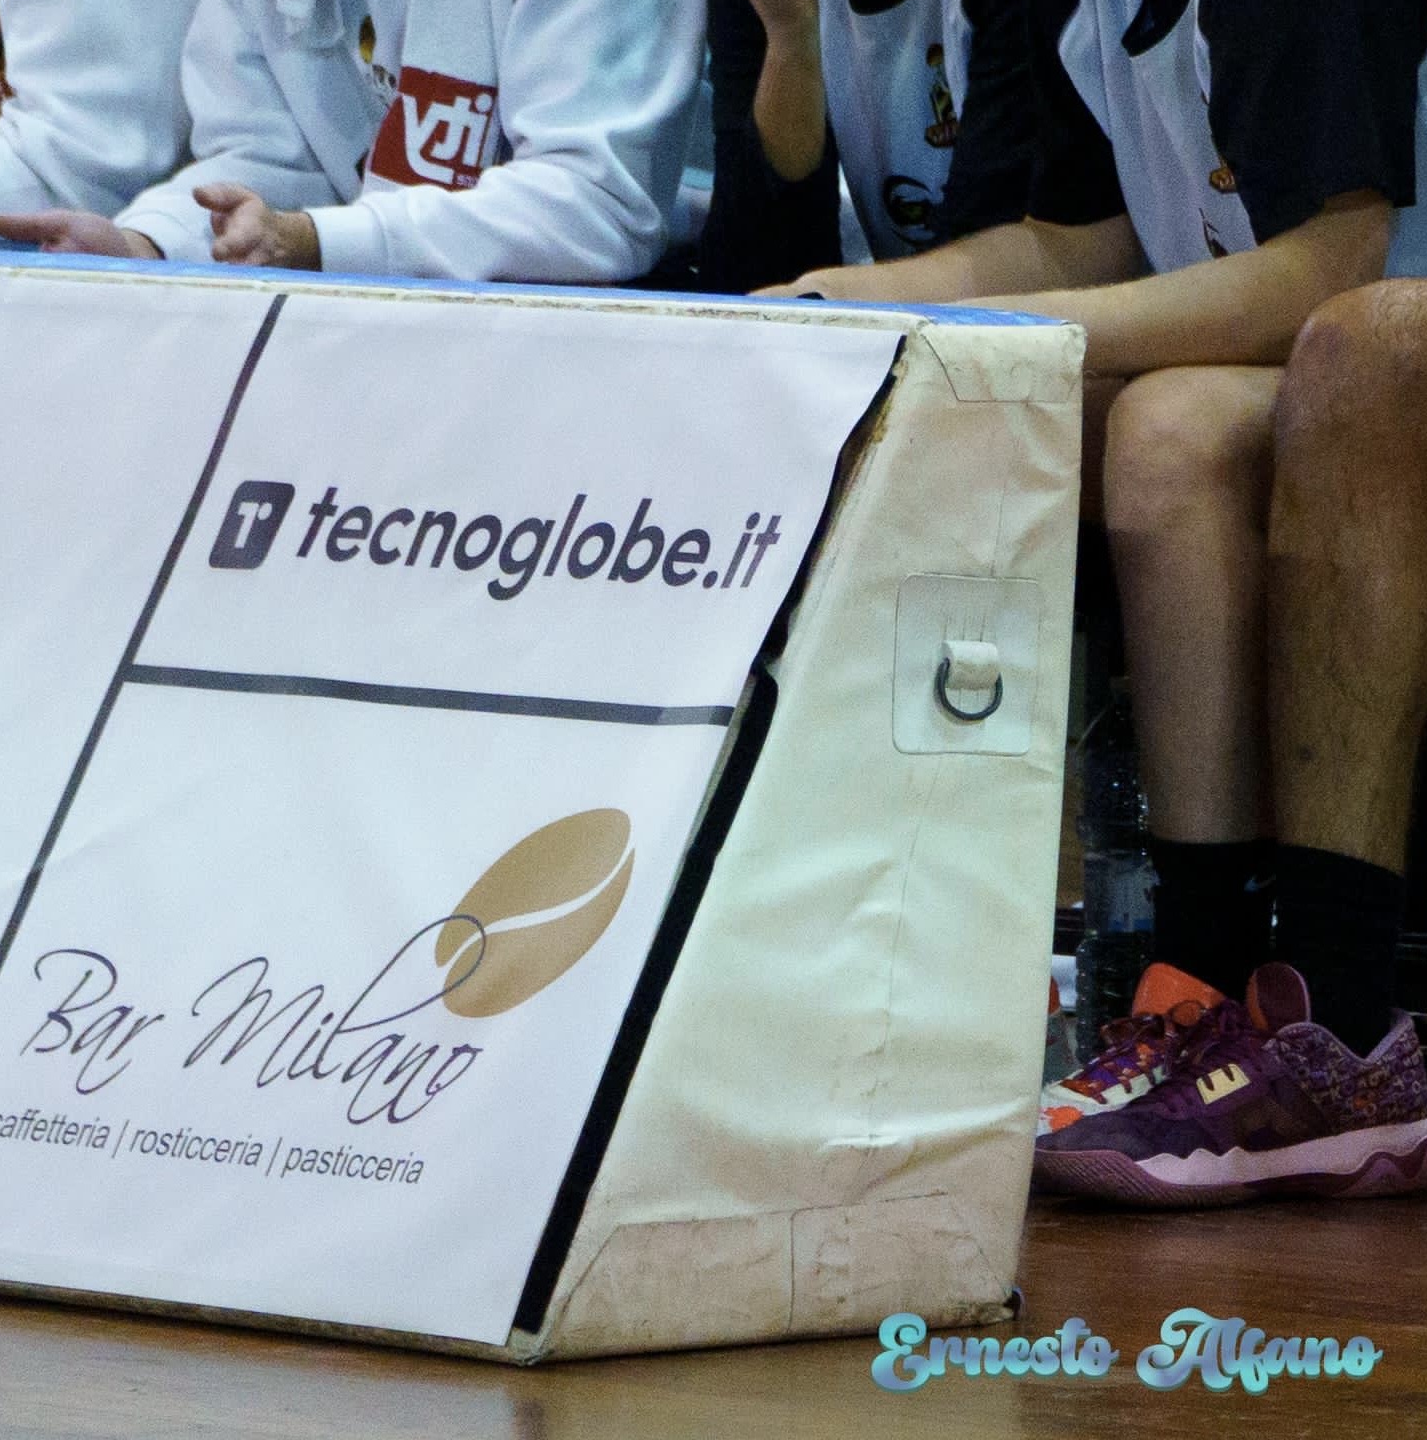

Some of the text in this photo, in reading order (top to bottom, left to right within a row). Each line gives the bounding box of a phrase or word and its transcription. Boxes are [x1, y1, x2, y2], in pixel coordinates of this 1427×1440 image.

[296, 487, 781, 601] tecnoglobe.it
[19, 915, 485, 1124] Bar Milano
[129, 1128, 263, 1167] rosticceria
[280, 1144, 424, 1185] pasticceria
